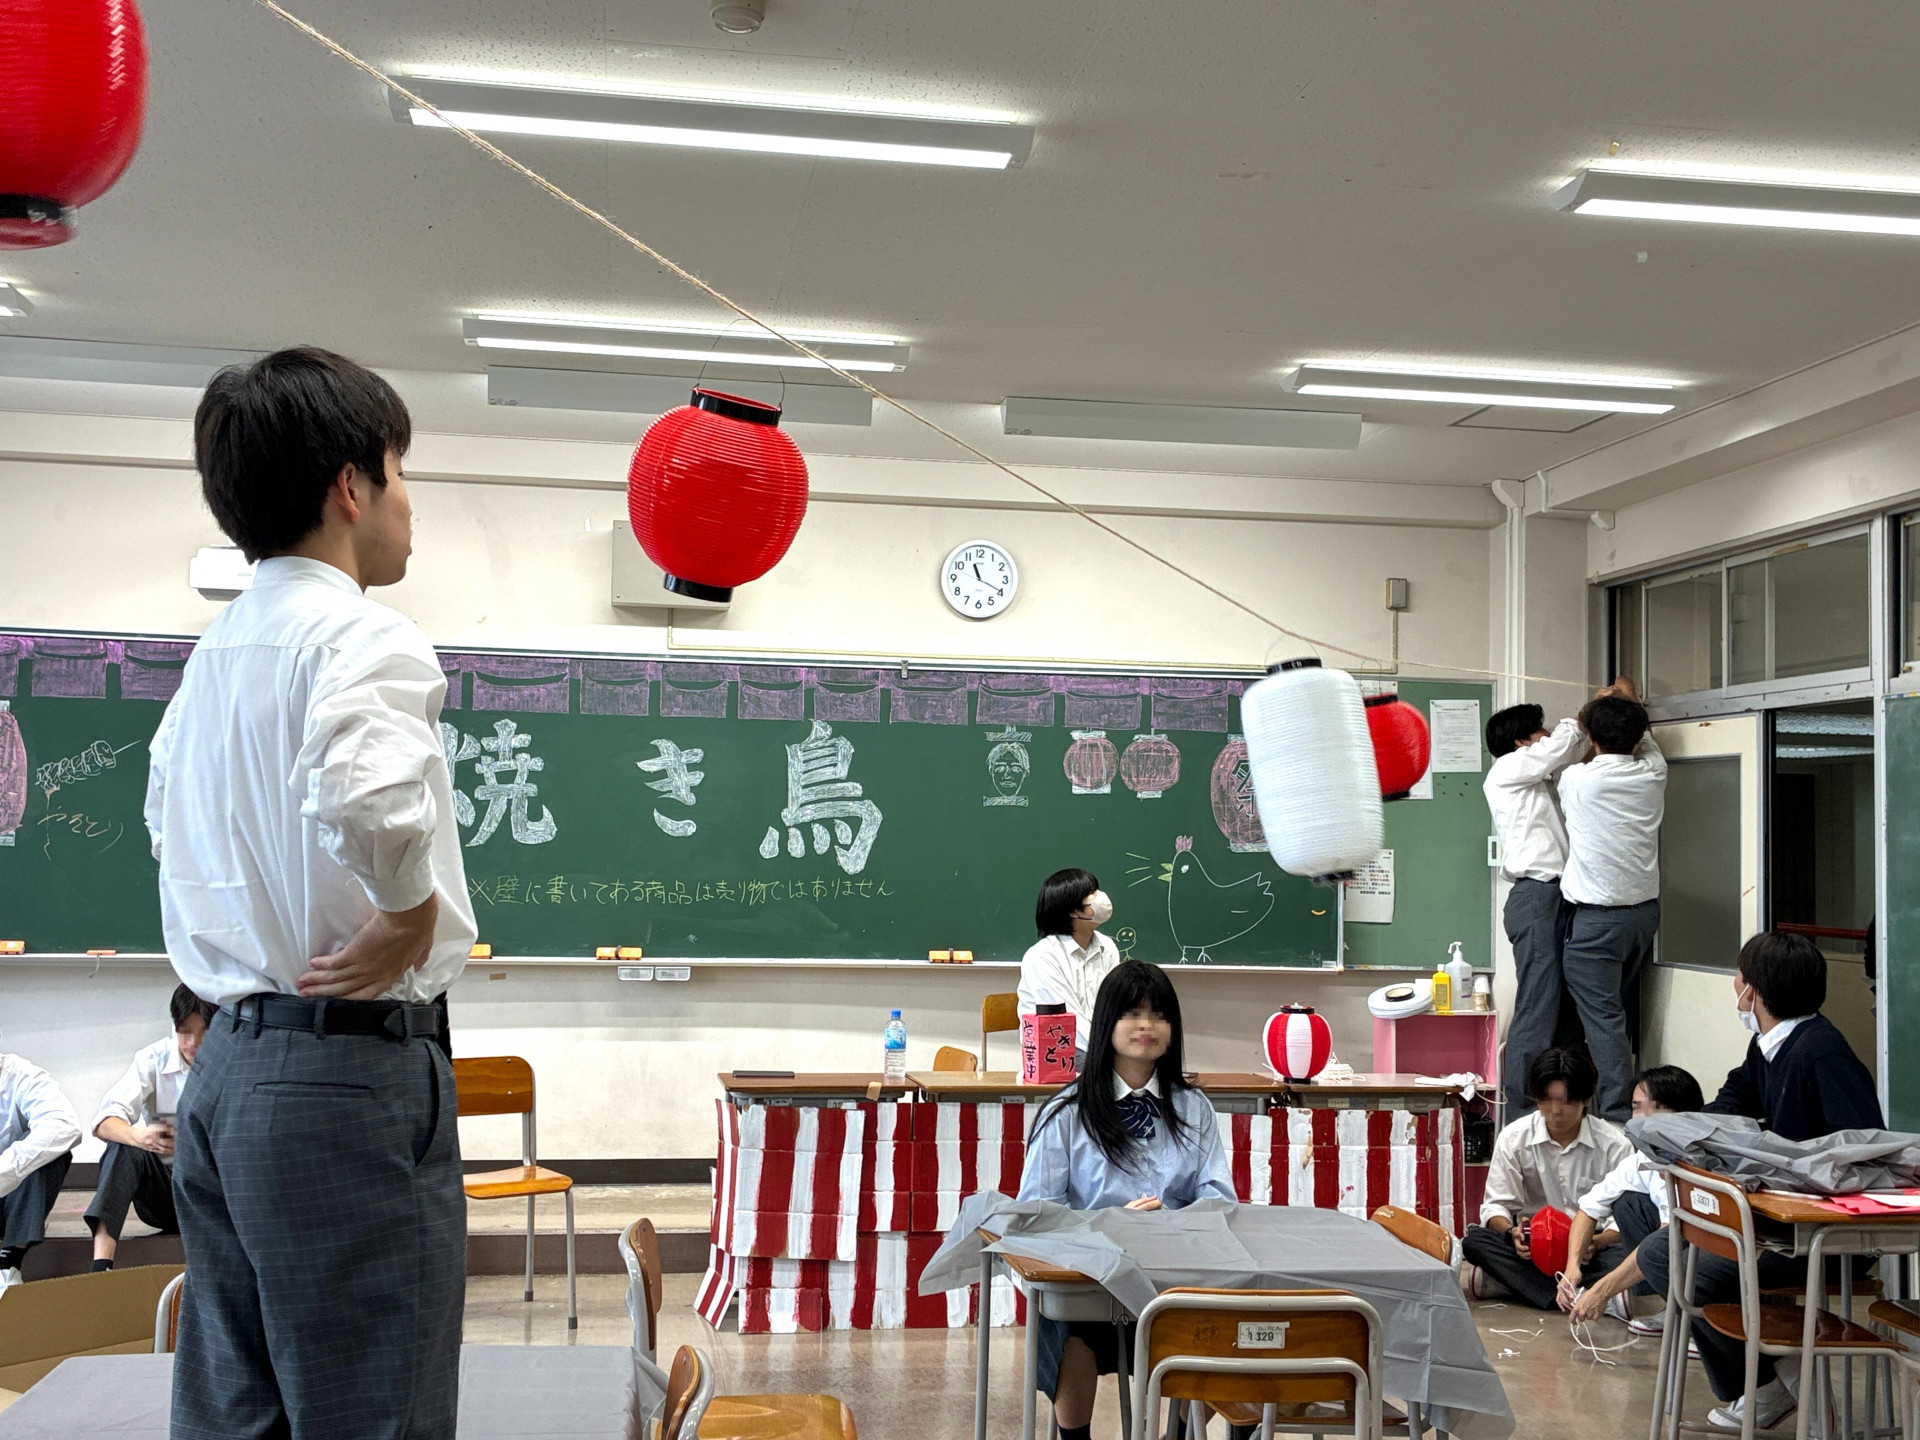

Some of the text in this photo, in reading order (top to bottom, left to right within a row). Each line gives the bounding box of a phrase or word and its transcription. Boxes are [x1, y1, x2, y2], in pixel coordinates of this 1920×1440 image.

[965, 553, 972, 561] 11
[976, 549, 985, 558] 12
[955, 561, 964, 570] 10
[998, 562, 1005, 571] 2
[950, 573, 957, 583] 9
[1002, 575, 1009, 585] 3
[954, 586, 961, 596] 8
[996, 588, 1004, 597] 4
[963, 596, 970, 605] 7
[975, 600, 982, 609] 6
[987, 596, 995, 606] 5
[438, 718, 884, 875] 焼き鳥
[1046, 1024, 1075, 1073] やきとり
